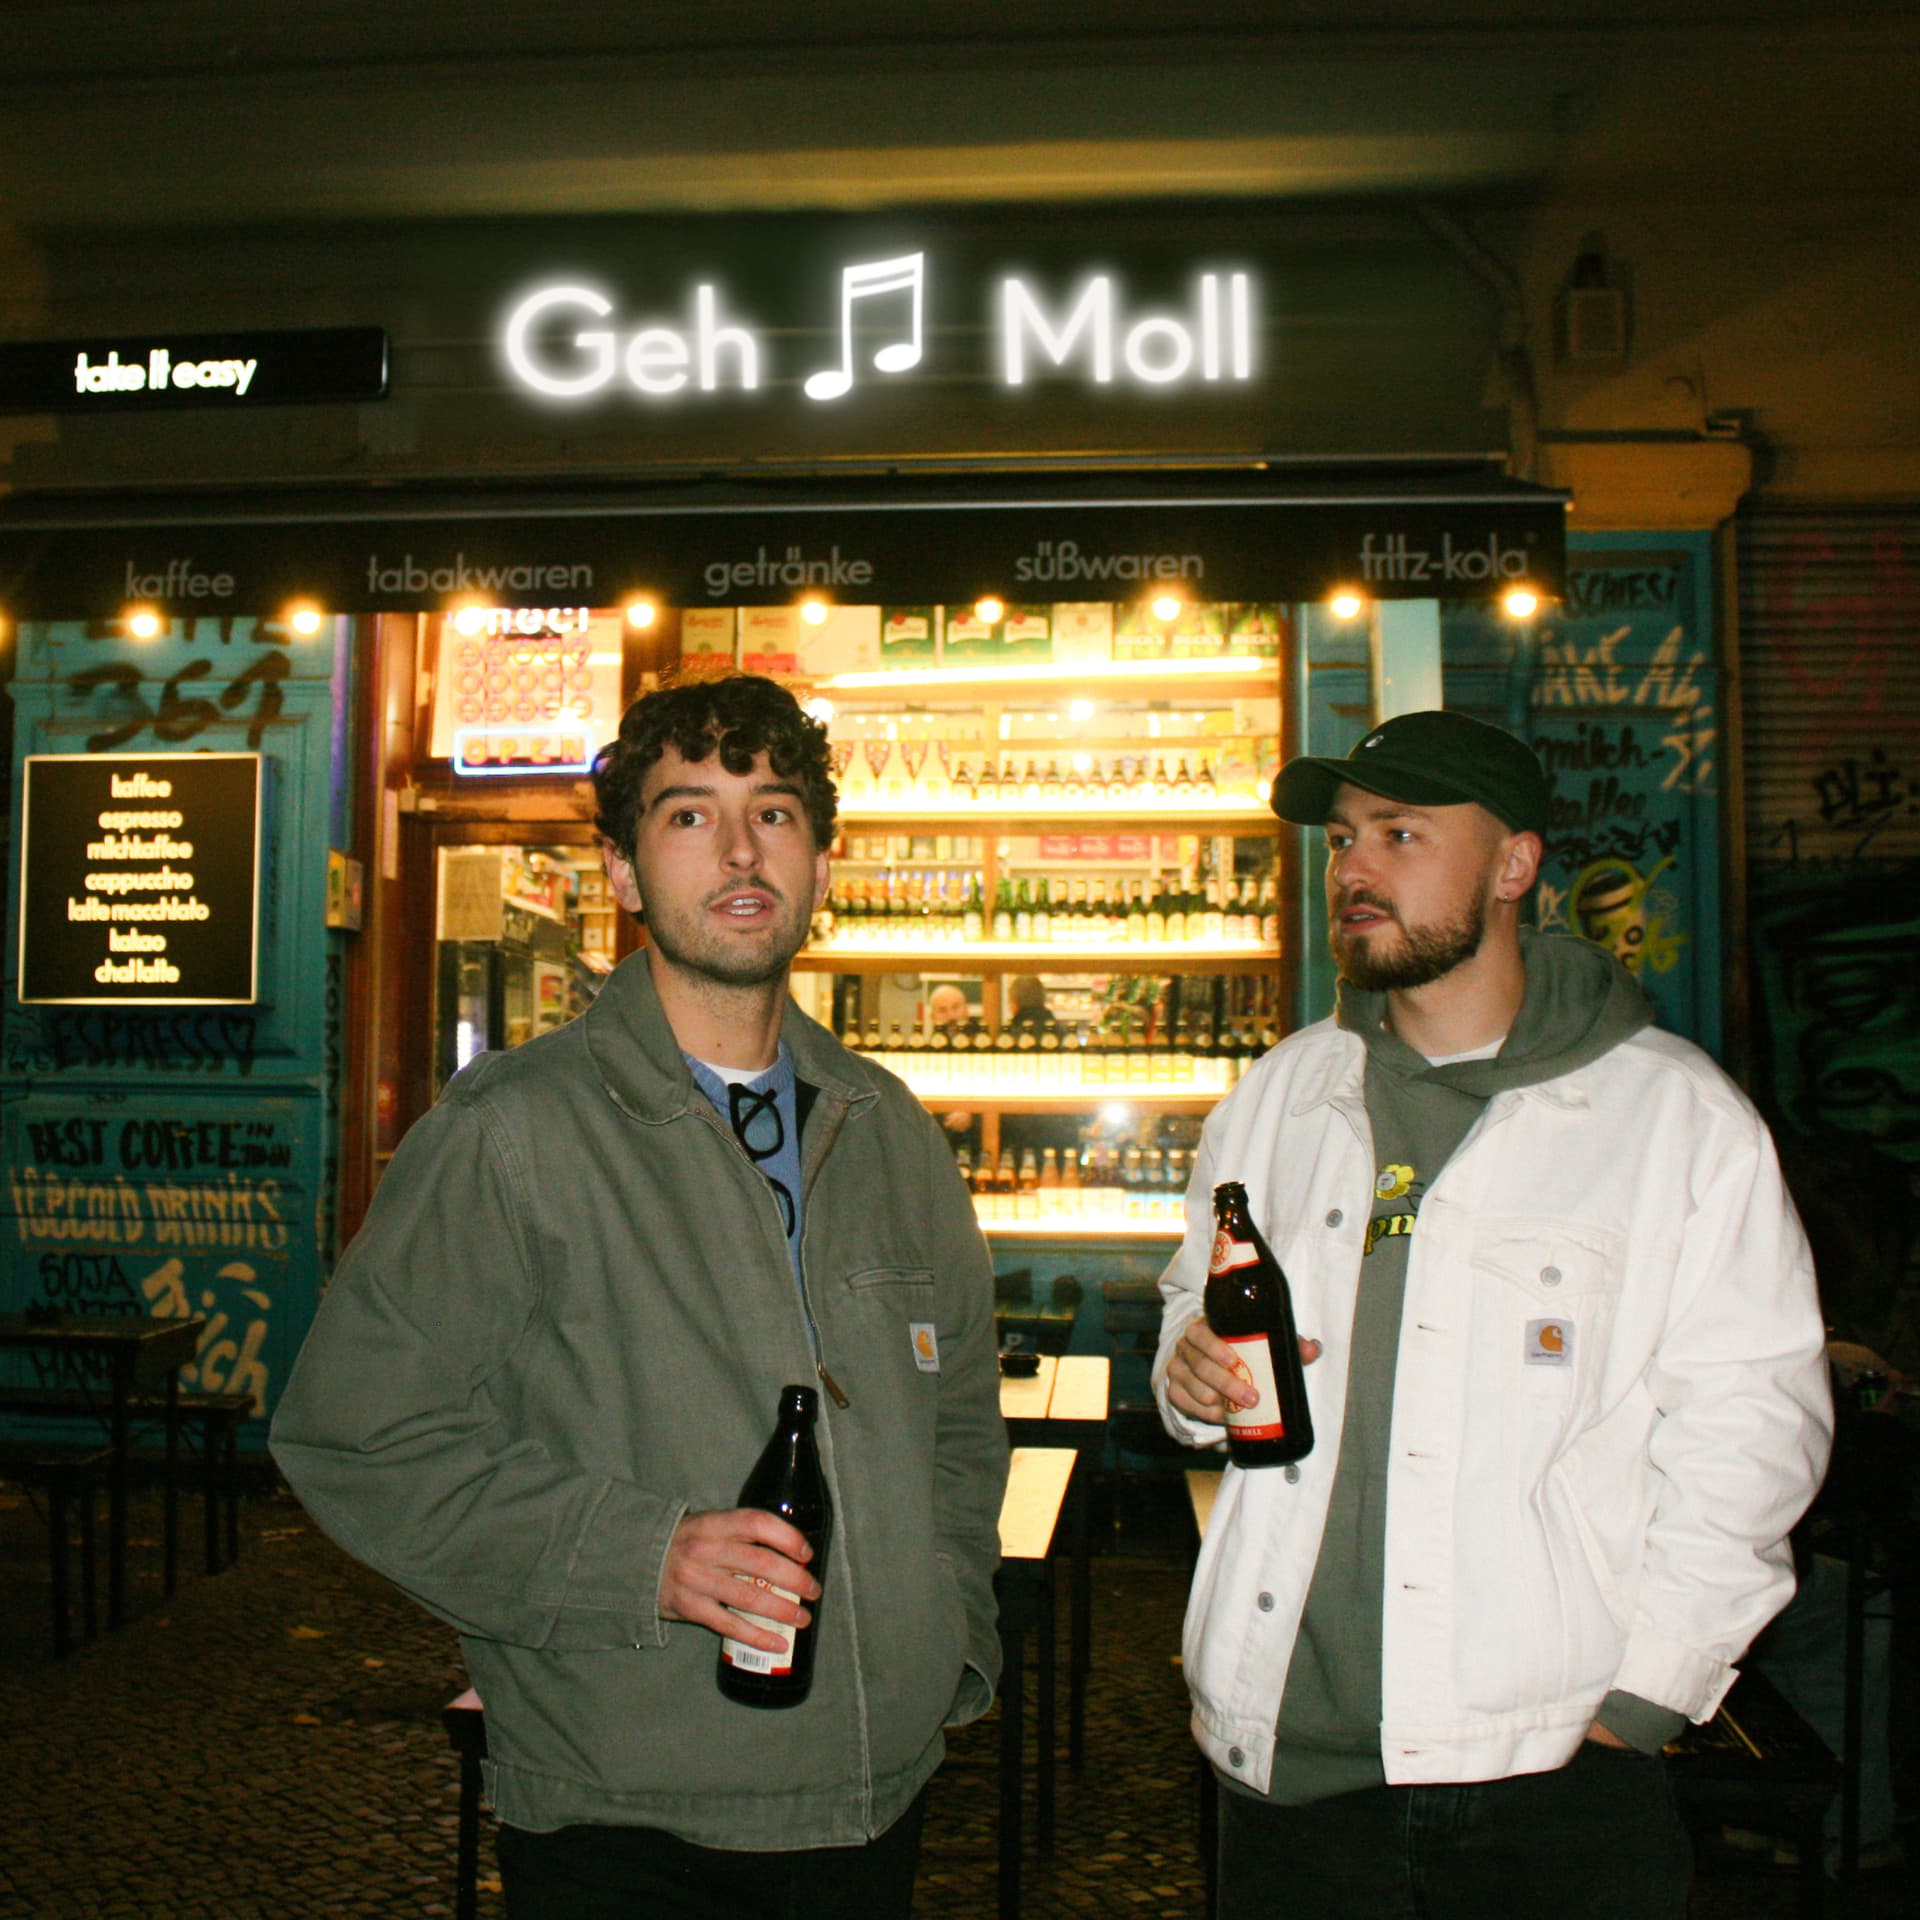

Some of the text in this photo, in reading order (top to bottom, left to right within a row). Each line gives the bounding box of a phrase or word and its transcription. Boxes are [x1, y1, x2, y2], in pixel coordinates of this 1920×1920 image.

[506, 274, 1249, 395] Geh Moll
[74, 349, 257, 396] take it easy
[704, 546, 873, 597] getränke
[1015, 541, 1205, 582] süßwaren
[1359, 531, 1529, 581] fritz-kola
[125, 559, 235, 599] kaffee
[367, 554, 594, 593] tabakwaren
[463, 738, 586, 766] OPEN
[111, 773, 172, 798] kaffee
[98, 811, 184, 833] espresso
[86, 834, 194, 860] milchkaffee
[84, 865, 195, 895] cappuccino
[67, 896, 210, 921] latte macchiato
[109, 927, 167, 952] kakao
[136, 958, 181, 983] latte
[27, 1117, 243, 1170] BEST COFFEE
